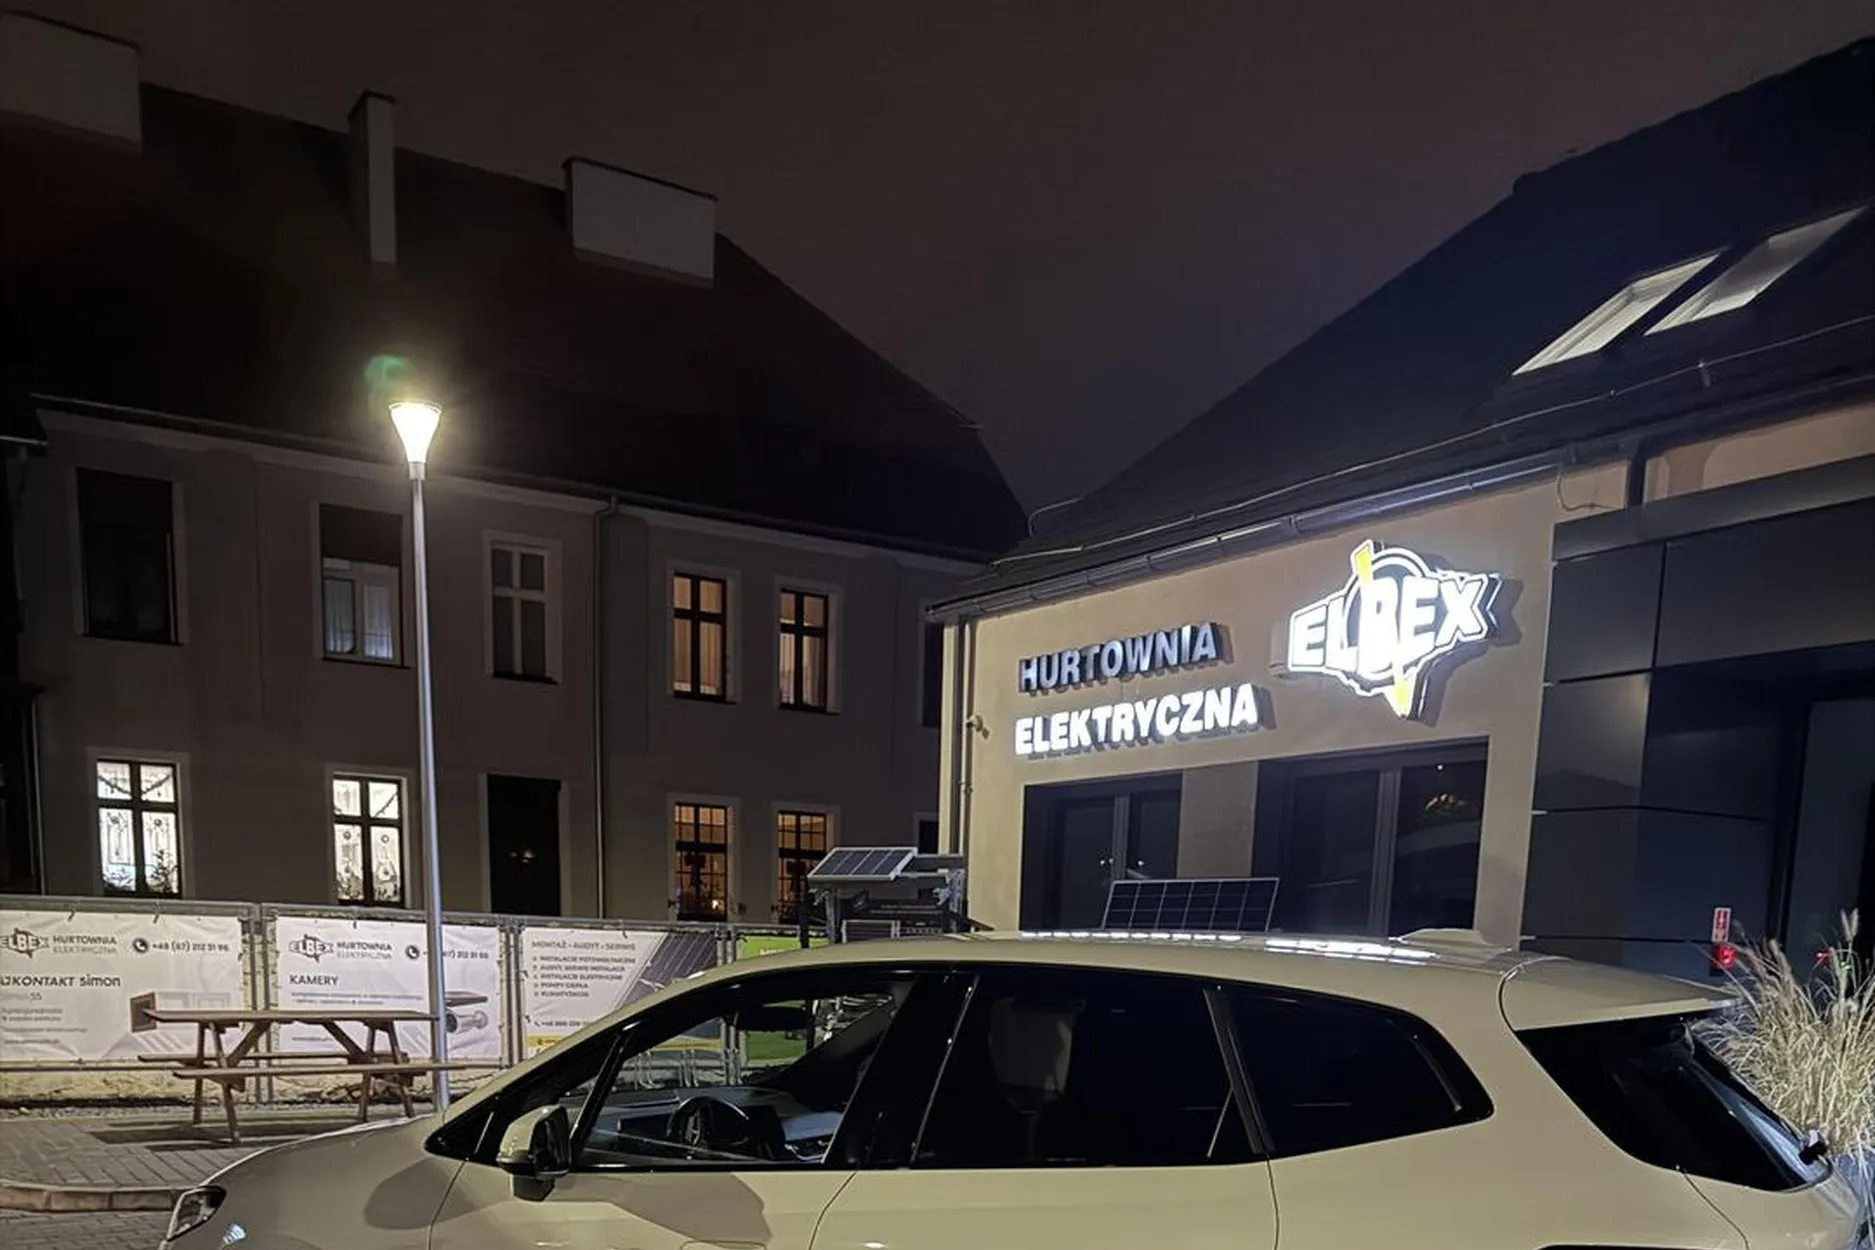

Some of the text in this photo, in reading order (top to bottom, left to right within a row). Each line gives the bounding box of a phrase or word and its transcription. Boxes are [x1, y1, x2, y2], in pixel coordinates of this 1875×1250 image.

[1020, 622, 1219, 691] HURTOWNIA
[1015, 683, 1258, 755] ELEKTRYCZNA
[53, 935, 117, 945] HURTOWNIA
[532, 939, 567, 948] MONTAŻ
[337, 941, 392, 951] HURTOWNIA
[289, 974, 339, 985] KAMERY
